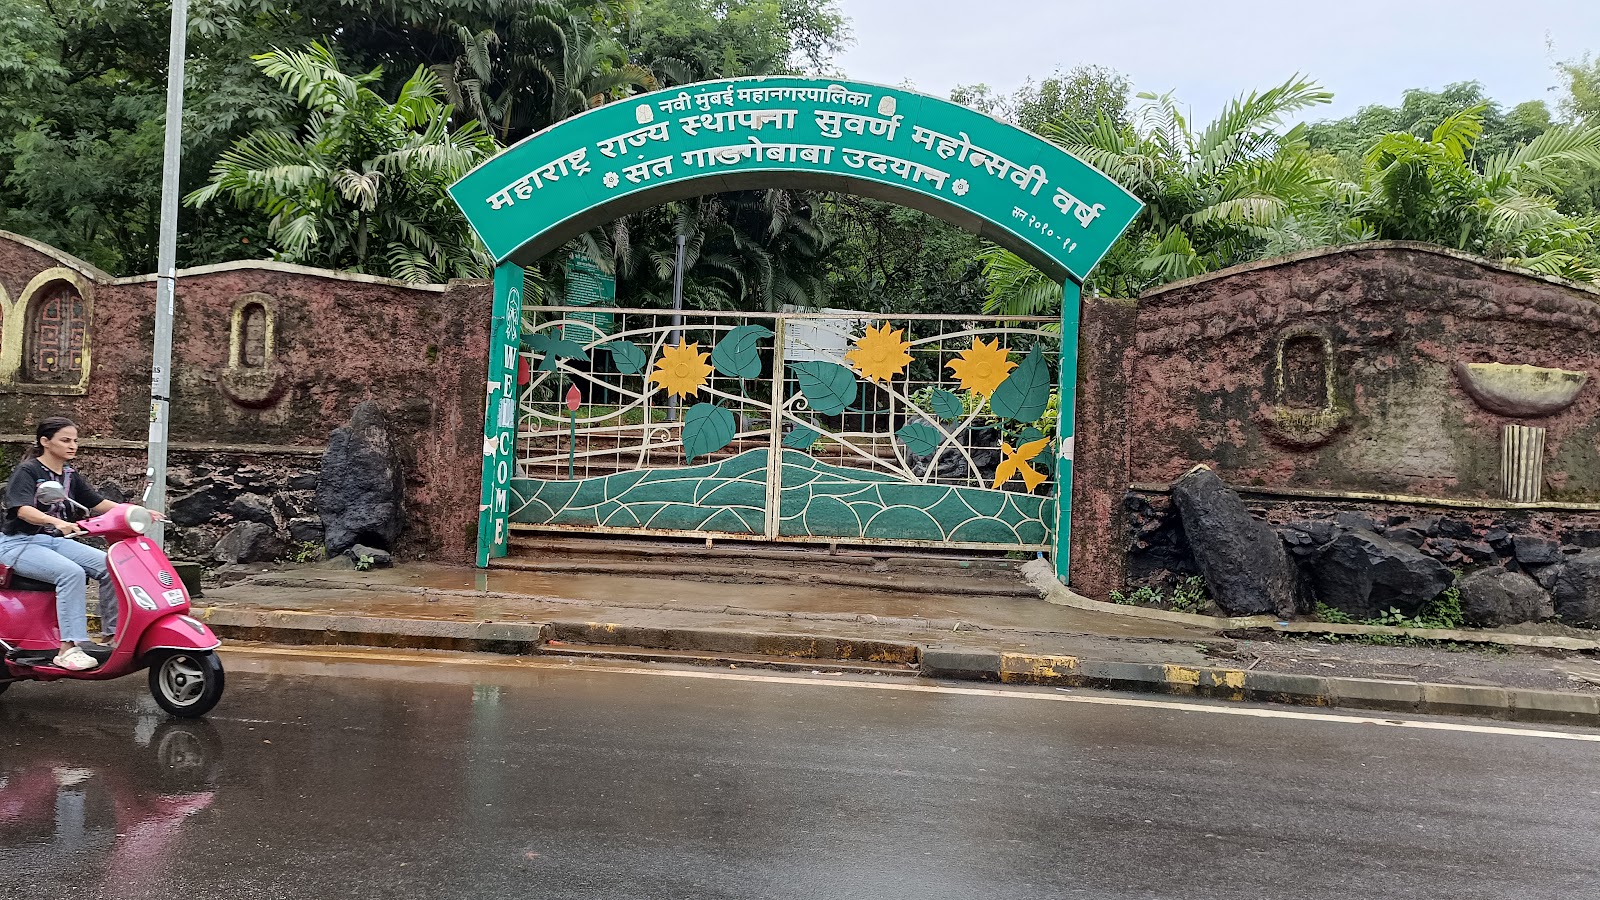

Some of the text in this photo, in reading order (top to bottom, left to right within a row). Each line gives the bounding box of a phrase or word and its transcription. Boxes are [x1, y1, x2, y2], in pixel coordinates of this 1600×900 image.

[658, 84, 873, 114] नवी मुंबई महानगरपालिका
[486, 147, 592, 210] महाराष्ट्र
[597, 120, 670, 158] राज्य
[679, 109, 799, 137] स्थापना
[814, 110, 905, 141] सुवर्ण
[1053, 186, 1106, 229] वर्ष
[622, 154, 673, 184] संत
[1012, 206, 1029, 222] सन
